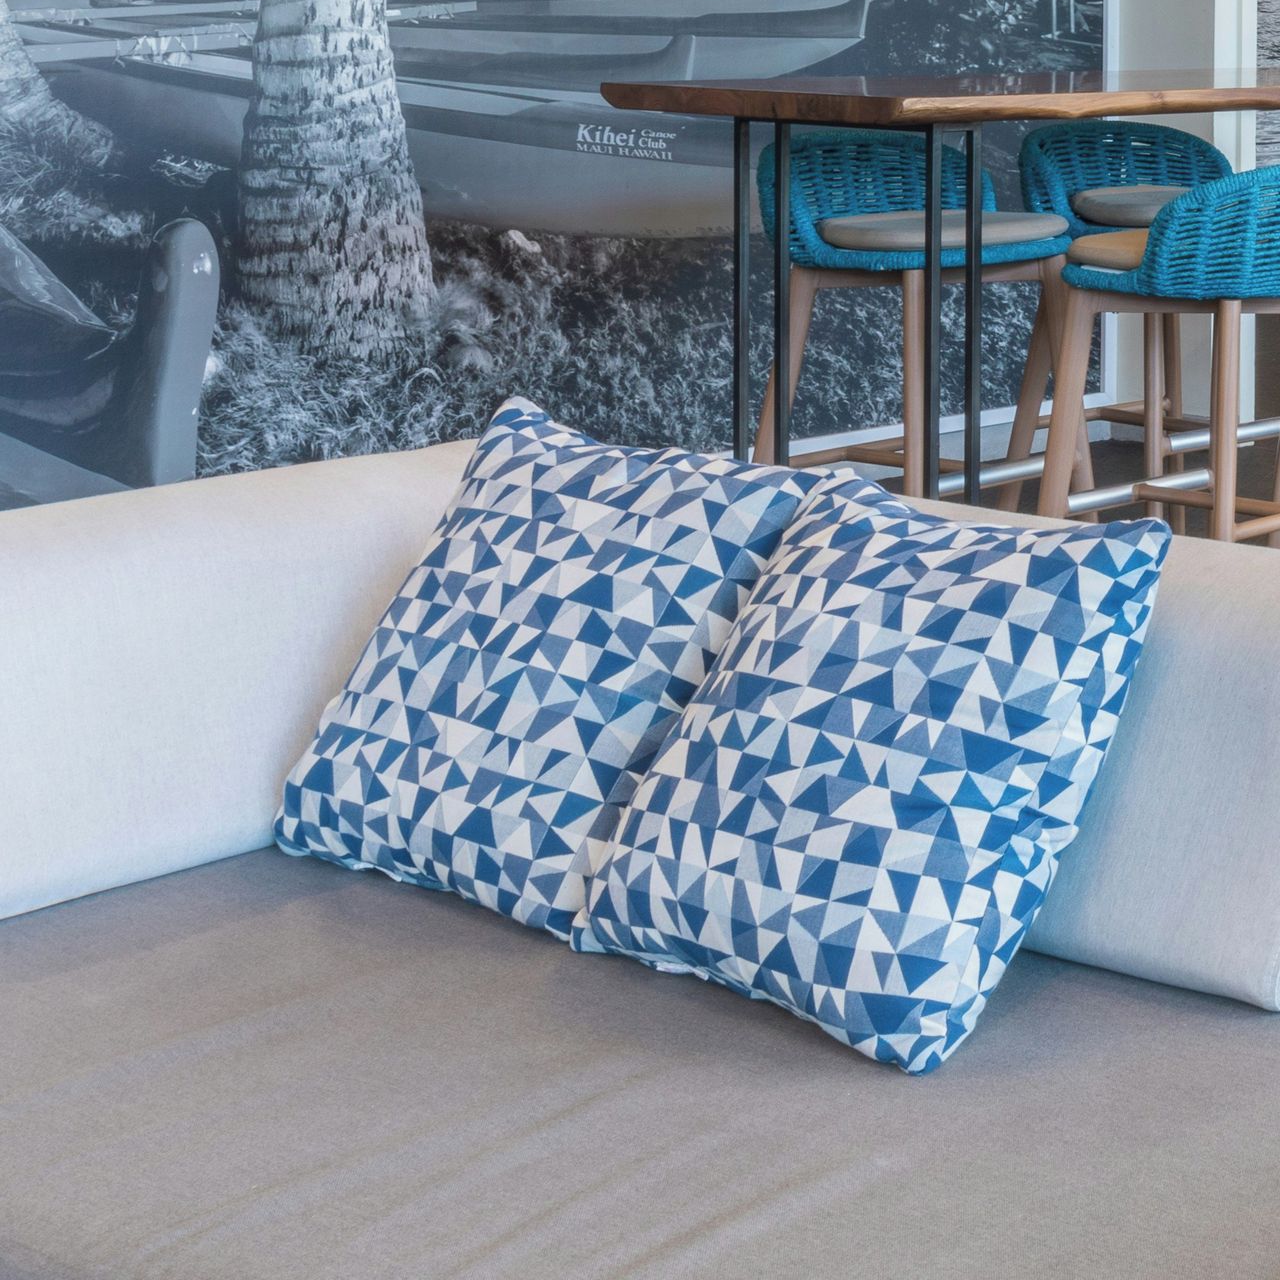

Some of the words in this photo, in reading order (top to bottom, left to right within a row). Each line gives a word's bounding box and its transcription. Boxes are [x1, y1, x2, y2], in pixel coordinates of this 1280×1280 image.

[576, 123, 636, 147] Kihei
[641, 129, 677, 139] Canoe
[638, 137, 666, 149] Club
[576, 143, 613, 154] MAUI
[617, 146, 673, 160] HAWAII
